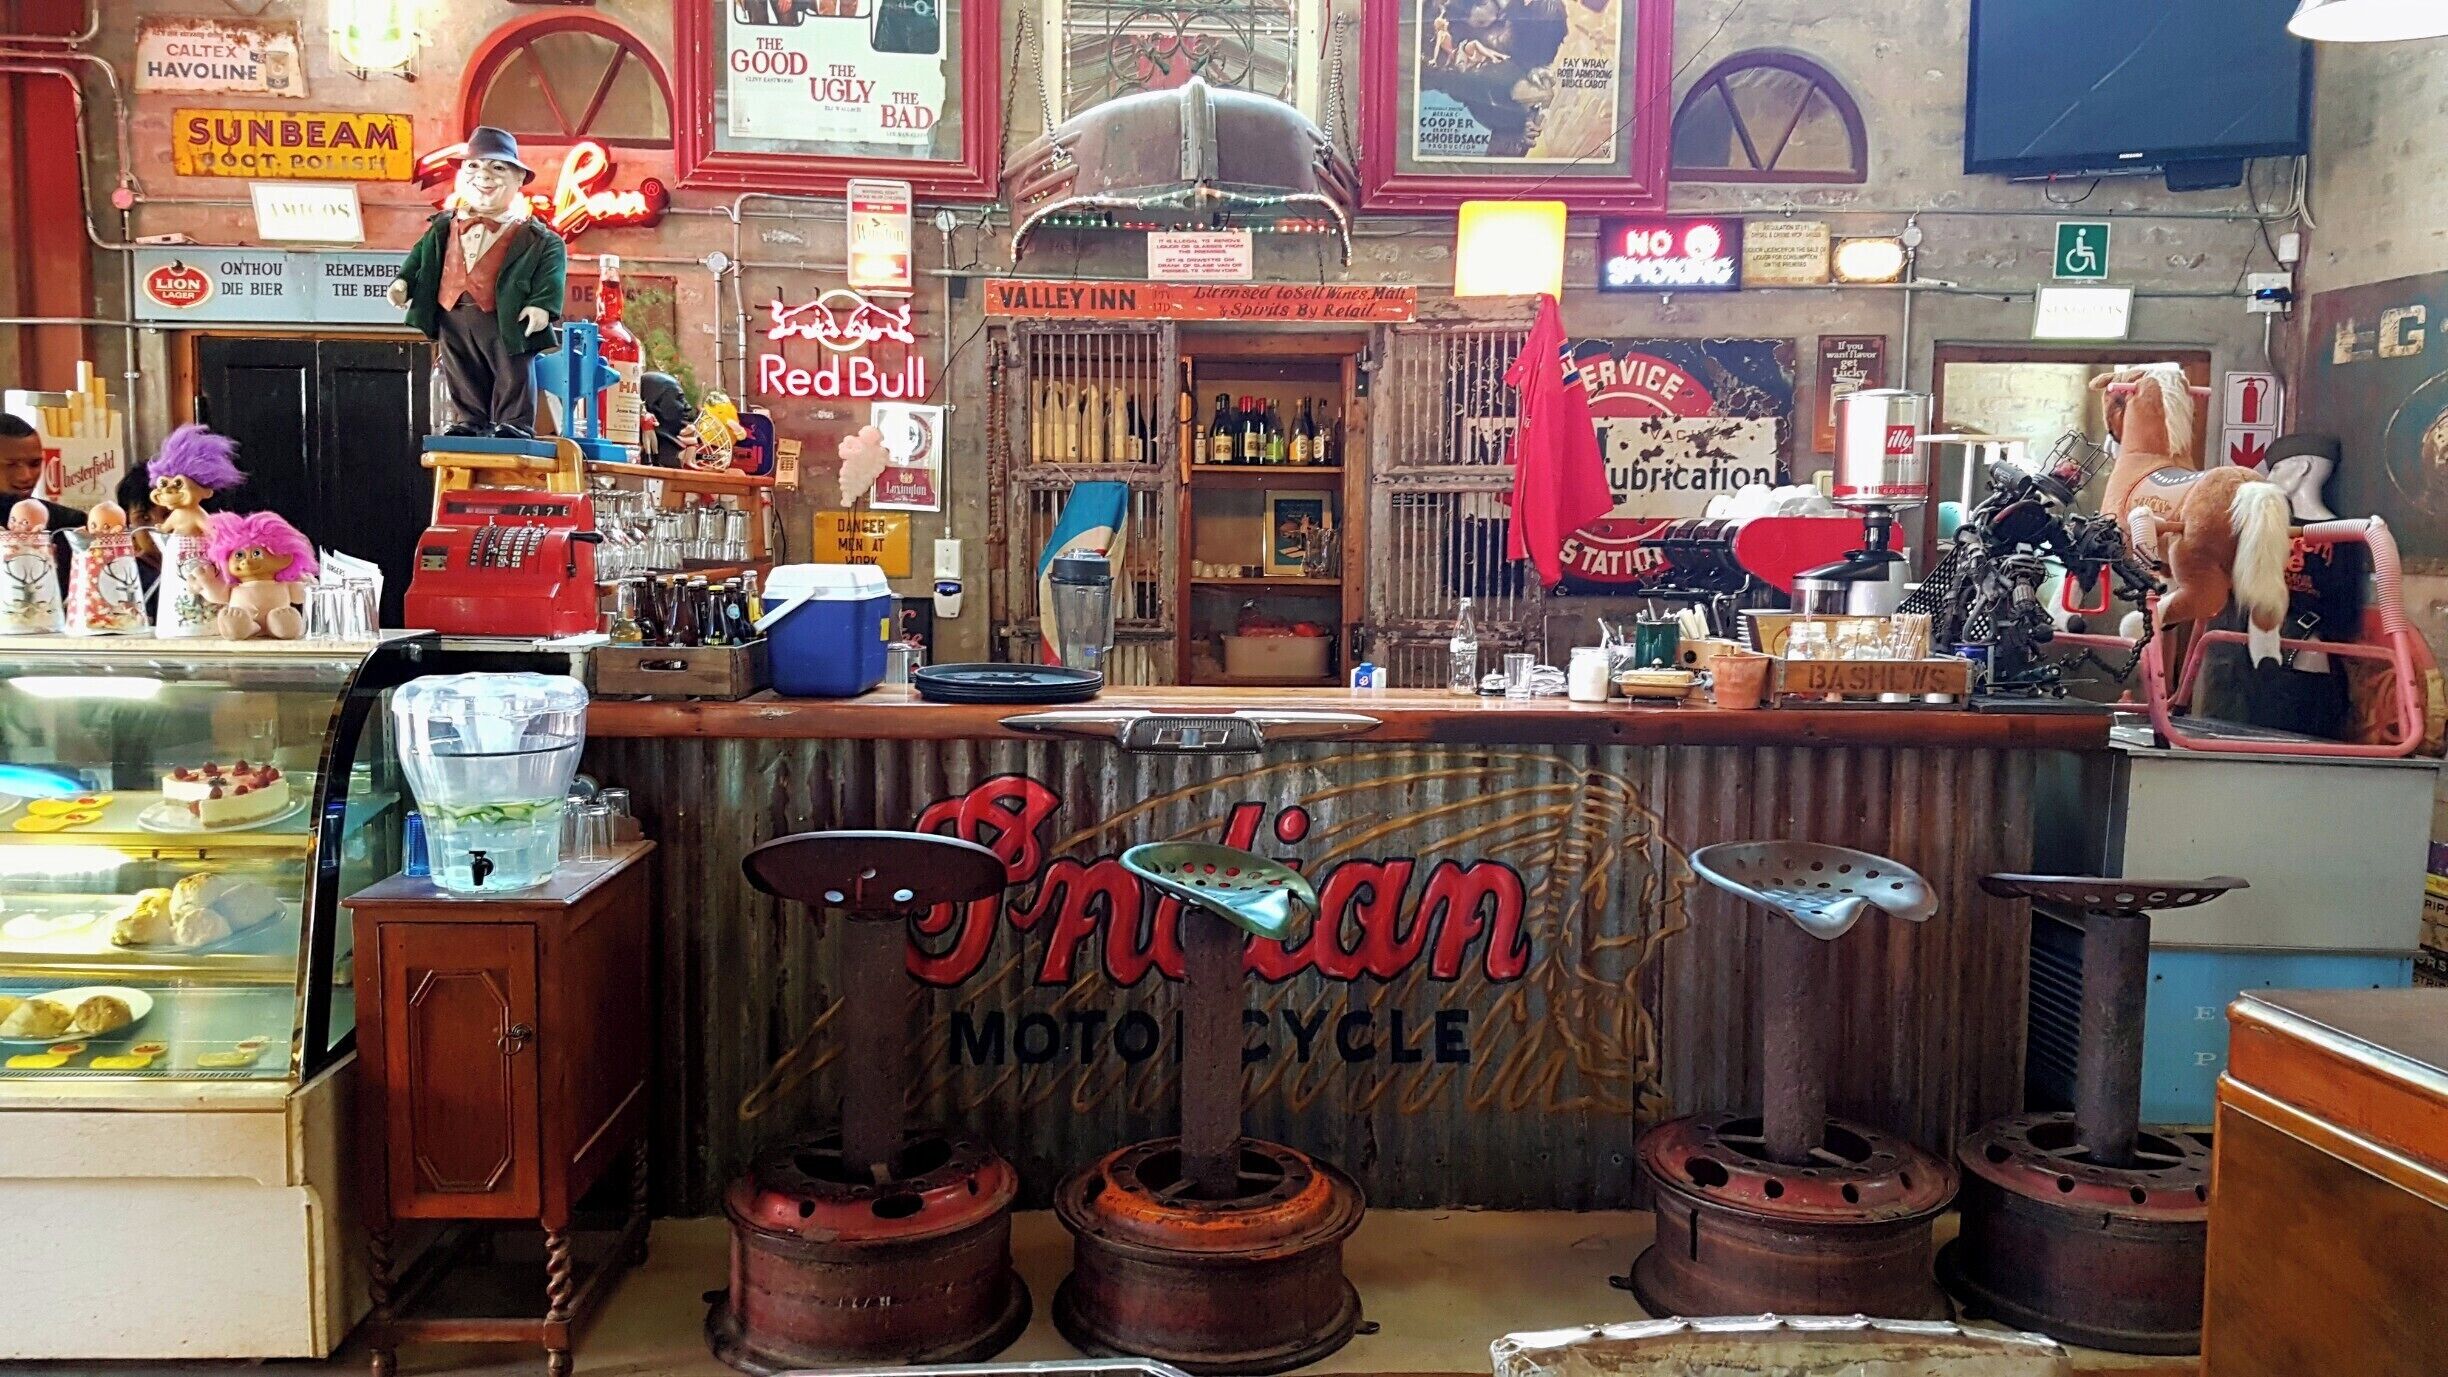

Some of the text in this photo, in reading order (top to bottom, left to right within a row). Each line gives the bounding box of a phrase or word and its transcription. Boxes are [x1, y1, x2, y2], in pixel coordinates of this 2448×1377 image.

[166, 44, 237, 58] CALTEX
[757, 37, 783, 50] THE
[731, 49, 808, 75] GOOD
[1563, 58, 1608, 68] FAY WRAY
[148, 62, 257, 80] HAVOLINE
[829, 64, 856, 77] THE
[810, 77, 875, 103] UGLY
[1584, 80, 1607, 89] CABOT
[892, 92, 919, 105] THE
[880, 104, 933, 130] BAD
[1420, 117, 1474, 128] COOPER
[188, 118, 398, 150] SUNBEAM
[1420, 132, 1490, 144] SCHOEDSACK
[291, 154, 387, 171] POLISH
[1626, 228, 1673, 257] NO
[221, 262, 282, 276] ONTHOU
[155, 278, 200, 290] LION
[221, 282, 283, 296] DIE BIER
[332, 283, 391, 298] THE BEE
[162, 291, 195, 300] LAGER
[1000, 286, 1136, 310] VALLEY INN
[1193, 285, 1272, 299] Licensed
[1231, 303, 1289, 318] Spirits
[1296, 304, 1318, 319] By
[1838, 341, 1864, 352] If you
[1849, 350, 1877, 358] flavor
[1840, 359, 1858, 370] get
[760, 354, 925, 398] Red Bull
[1578, 358, 1685, 401] ERVICE
[1832, 367, 1868, 380] Lucky
[1887, 430, 1913, 452] illy
[45, 450, 115, 494] Chesterfield
[1611, 459, 1770, 491] ubrication
[886, 481, 927, 497] Lexington
[837, 518, 885, 533] DANGER
[838, 538, 885, 552] MEN AT
[905, 773, 1531, 986] Indian
[947, 1008, 1471, 1066] MOTOCYCLE
